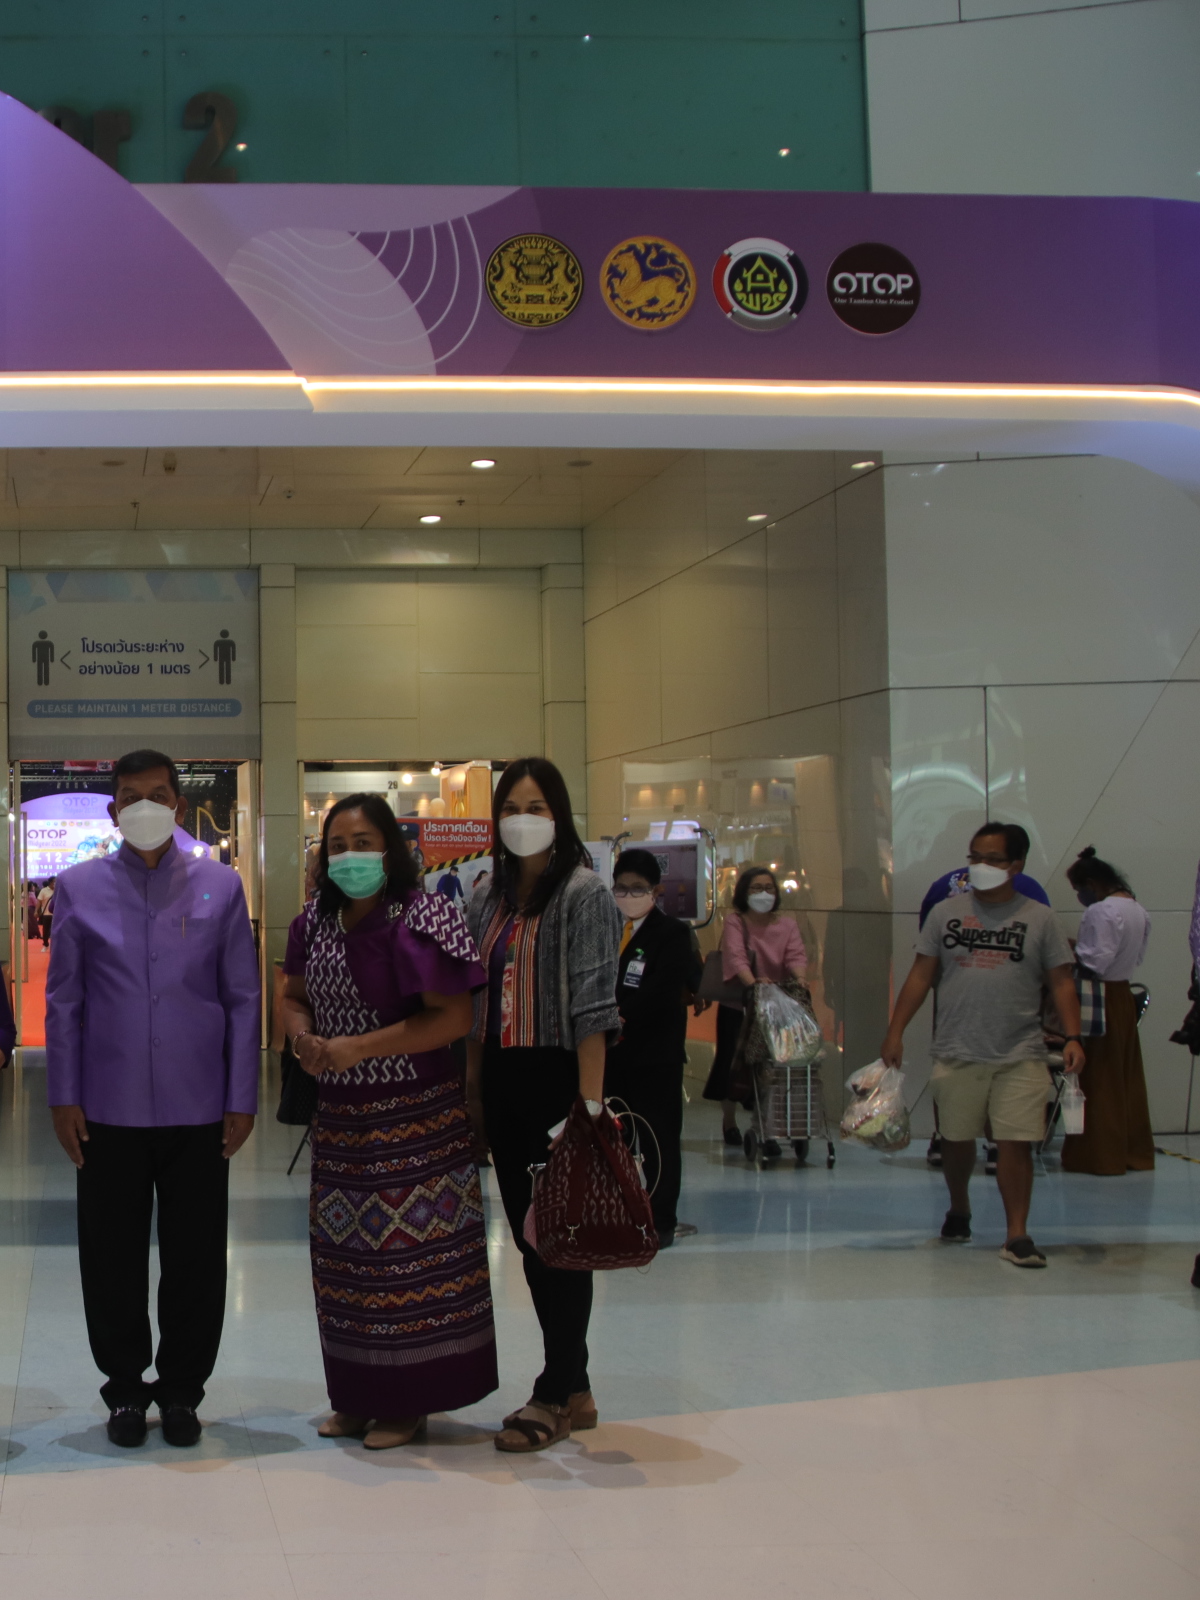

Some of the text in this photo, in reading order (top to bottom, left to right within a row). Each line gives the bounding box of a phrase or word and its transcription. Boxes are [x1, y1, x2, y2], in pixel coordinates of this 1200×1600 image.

[184, 92, 237, 183] 2
[833, 272, 914, 295] OTOP
[81, 637, 185, 653] โปรดเว้นระยะห่าง
[79, 661, 191, 675] อย่างน้อย 1 เมตร
[35, 703, 231, 713] PLEASE MAINTAIN 1 METER DISTANCE
[62, 796, 98, 807] OTOP
[27, 829, 67, 839] OTOP
[424, 821, 488, 833] ประกาศเตือน
[943, 919, 1025, 962] Superdry
